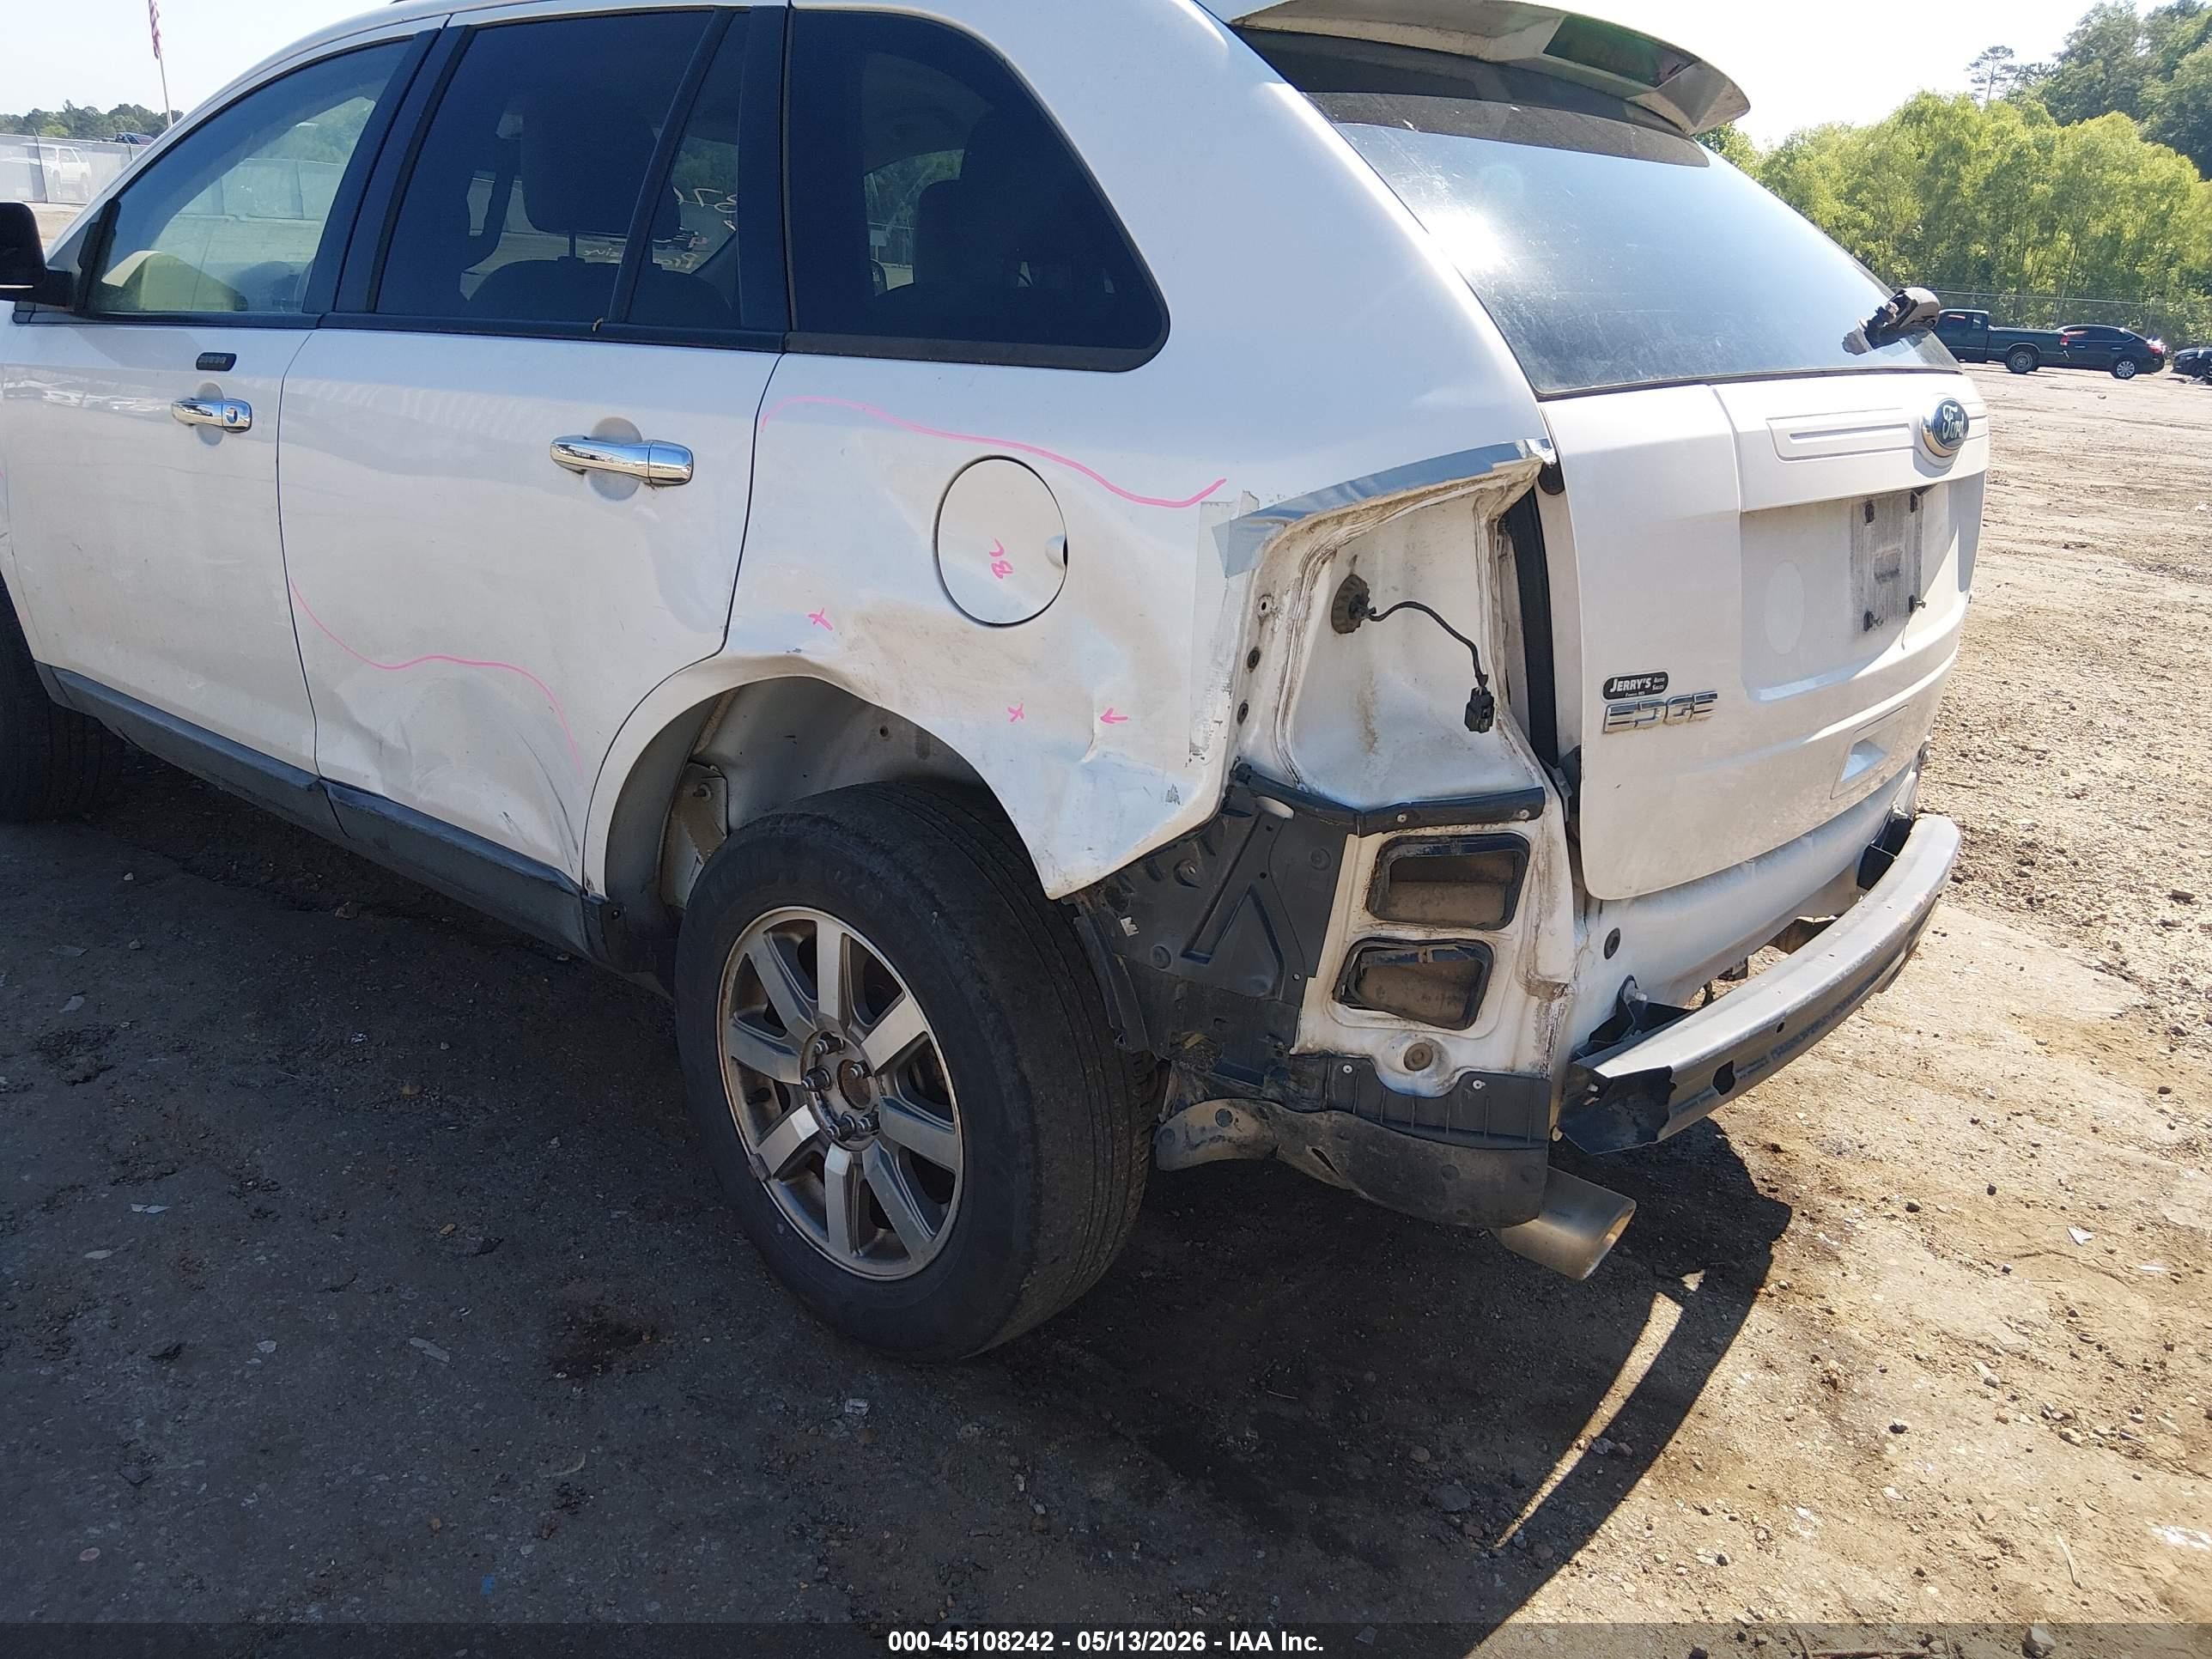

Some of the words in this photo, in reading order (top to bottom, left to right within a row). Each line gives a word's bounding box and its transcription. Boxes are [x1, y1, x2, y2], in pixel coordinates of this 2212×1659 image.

[1942, 404, 1965, 440] Ford
[1609, 678, 1652, 693] JERRY'S
[1602, 690, 1718, 734] EDGE
